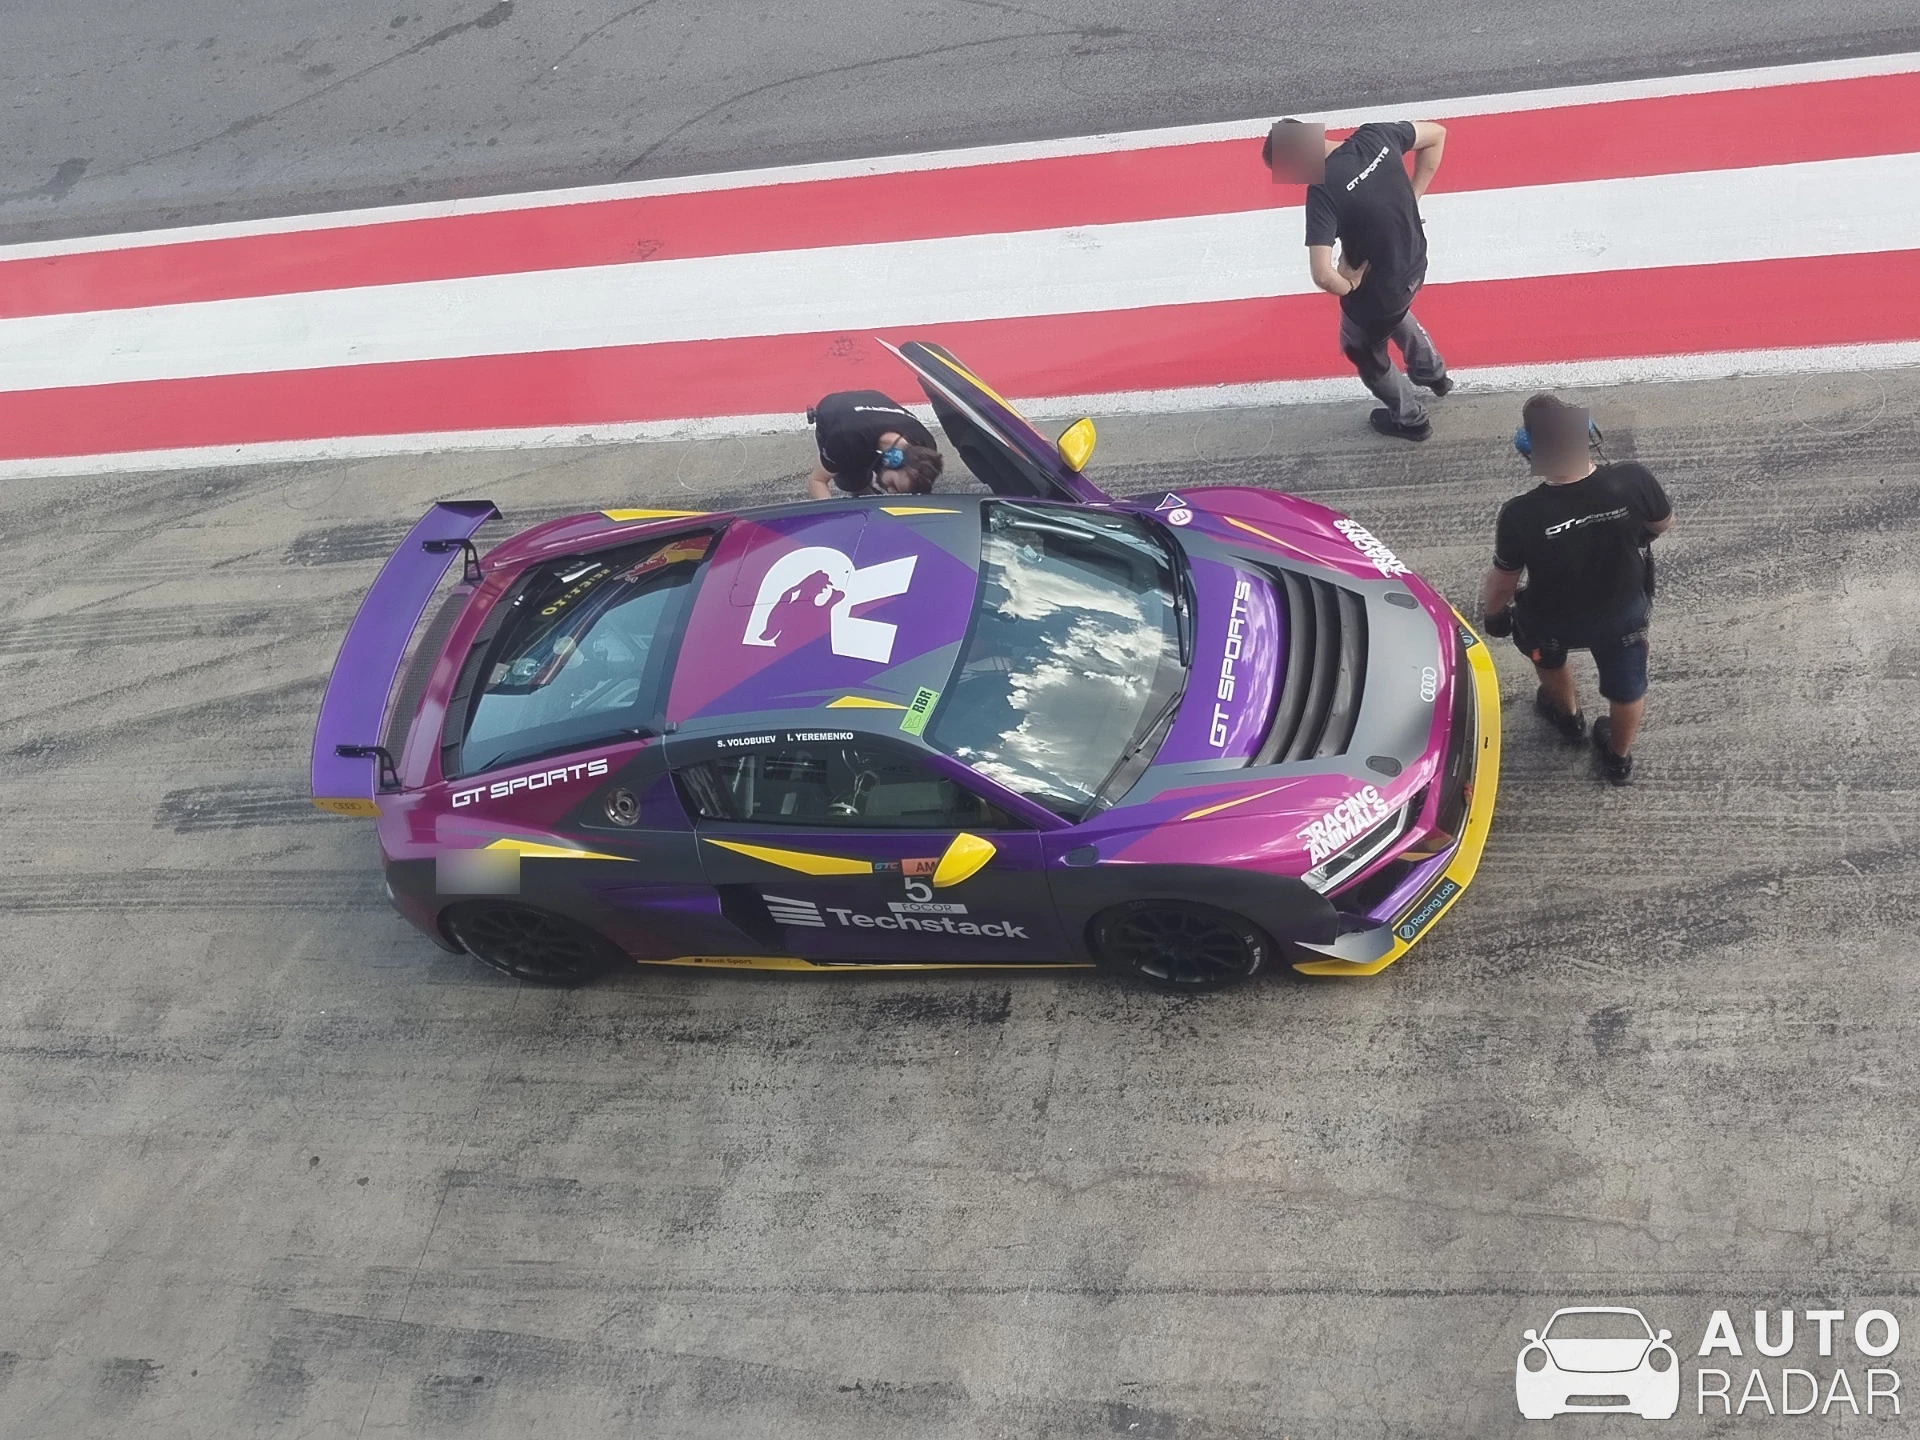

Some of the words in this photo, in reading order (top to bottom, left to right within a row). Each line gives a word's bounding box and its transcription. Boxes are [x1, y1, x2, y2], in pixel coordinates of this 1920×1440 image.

[1172, 510, 1189, 523] E
[1545, 518, 1576, 536] GT
[1217, 580, 1251, 702] SPORTS
[912, 690, 932, 714] RBR
[717, 740, 726, 748] S.
[727, 735, 777, 747] VOLOBUIEV
[795, 732, 854, 742] YEREMENKO
[1209, 703, 1229, 748] GT
[452, 786, 486, 808] GT
[490, 758, 608, 799] SPORTS
[1308, 785, 1378, 842] RACING
[1310, 798, 1389, 866] ANIMALS
[874, 862, 899, 870] GTC
[904, 876, 933, 903] 5
[901, 903, 953, 912] FOCOR
[1410, 898, 1442, 927] Racing
[1436, 883, 1455, 900] Lab
[826, 907, 1030, 939] Techstack
